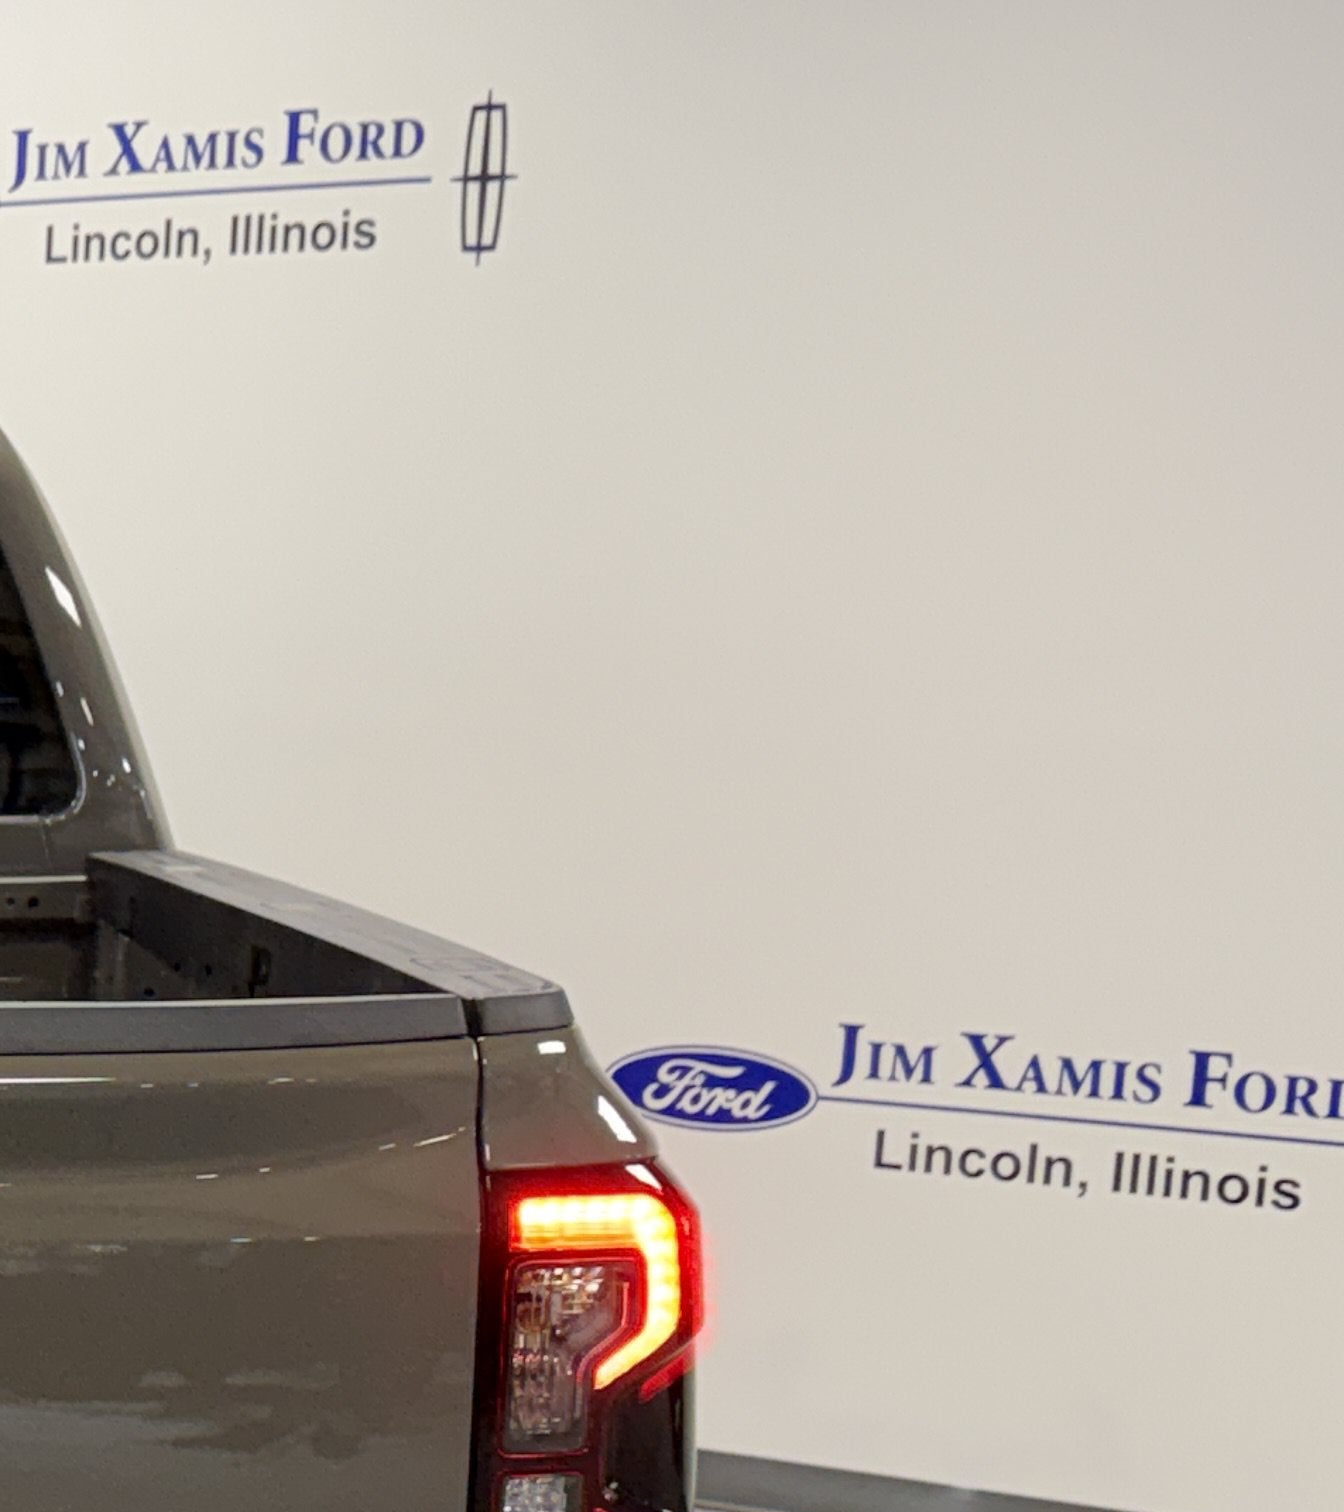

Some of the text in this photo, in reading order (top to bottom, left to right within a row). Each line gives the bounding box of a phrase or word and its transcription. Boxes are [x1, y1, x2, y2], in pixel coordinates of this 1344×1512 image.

[44, 209, 377, 264] Lincoln, Illinois
[642, 1058, 774, 1121] Ford
[872, 1129, 1302, 1211] Lincoln, Illinois
